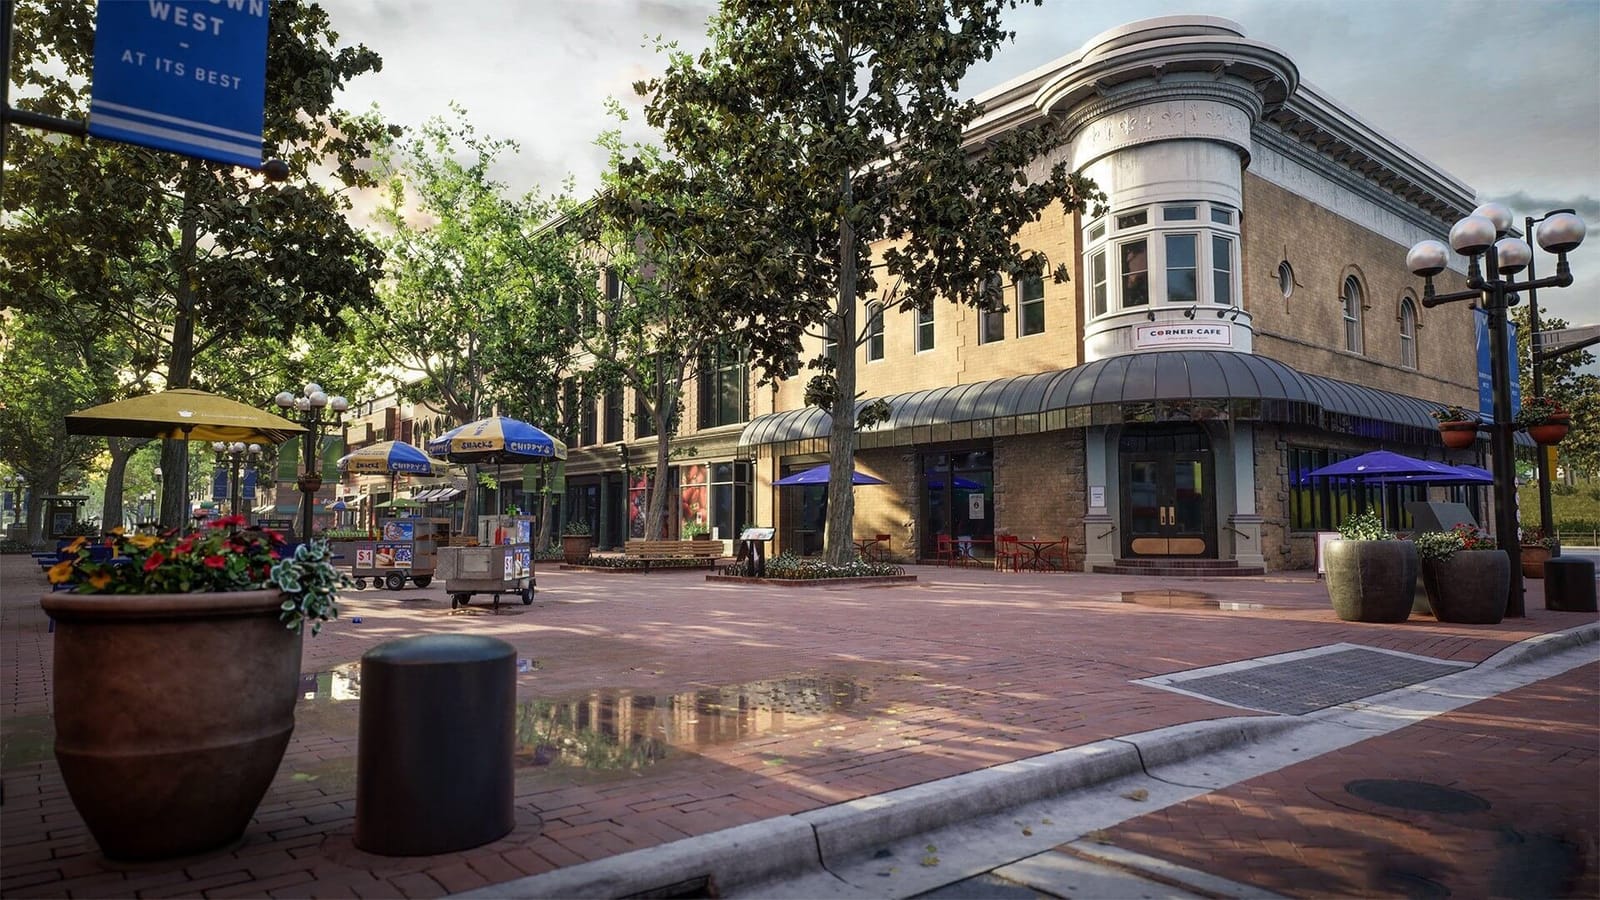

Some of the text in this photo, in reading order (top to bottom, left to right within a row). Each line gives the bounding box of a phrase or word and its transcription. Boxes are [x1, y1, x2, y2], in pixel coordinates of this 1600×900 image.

[209, 0, 264, 17] WN
[149, 0, 224, 35] WEST
[121, 49, 241, 90] AT ITS BEST
[461, 440, 493, 449] SNACKS
[510, 441, 550, 454] CHIPPY'S
[392, 462, 427, 471] CHIPPY'S
